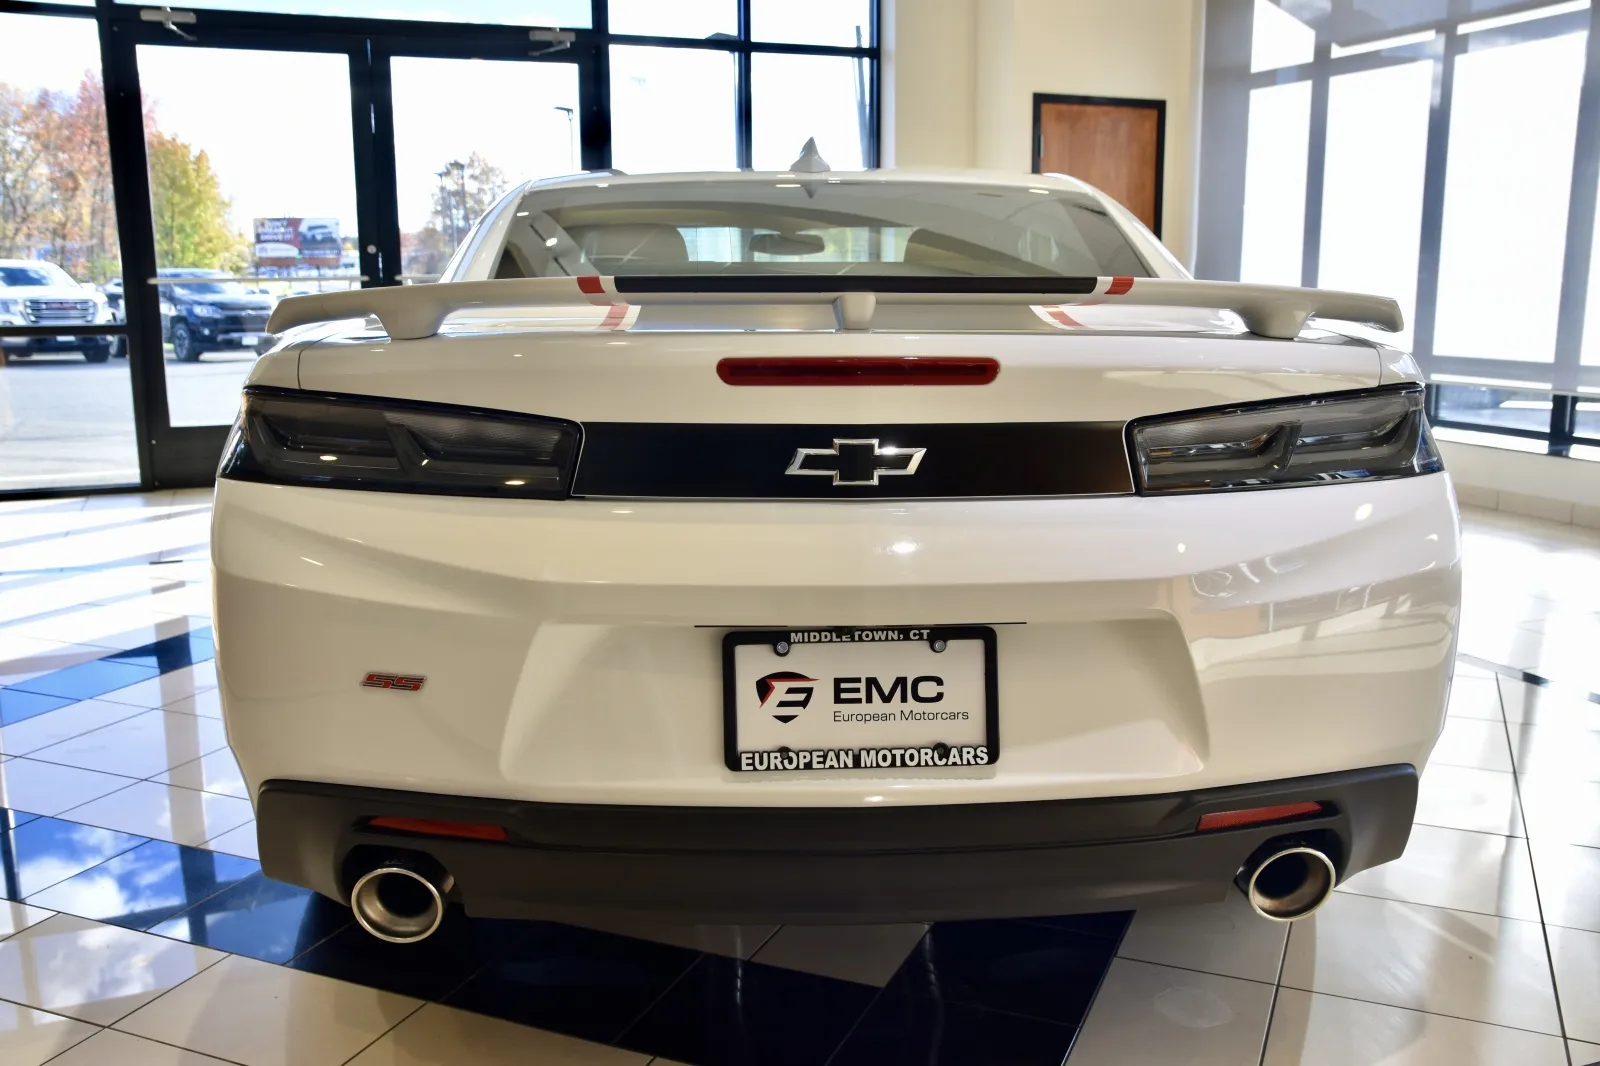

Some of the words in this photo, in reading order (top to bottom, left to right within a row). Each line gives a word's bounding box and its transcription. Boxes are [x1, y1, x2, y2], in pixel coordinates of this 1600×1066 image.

[909, 629, 931, 640] CT
[361, 672, 426, 691] SS
[833, 675, 945, 705] EMC
[833, 710, 896, 724] European
[900, 709, 969, 721] Motorcars
[741, 750, 854, 771] EUROPEAN
[860, 746, 989, 768] MOTORCARS
